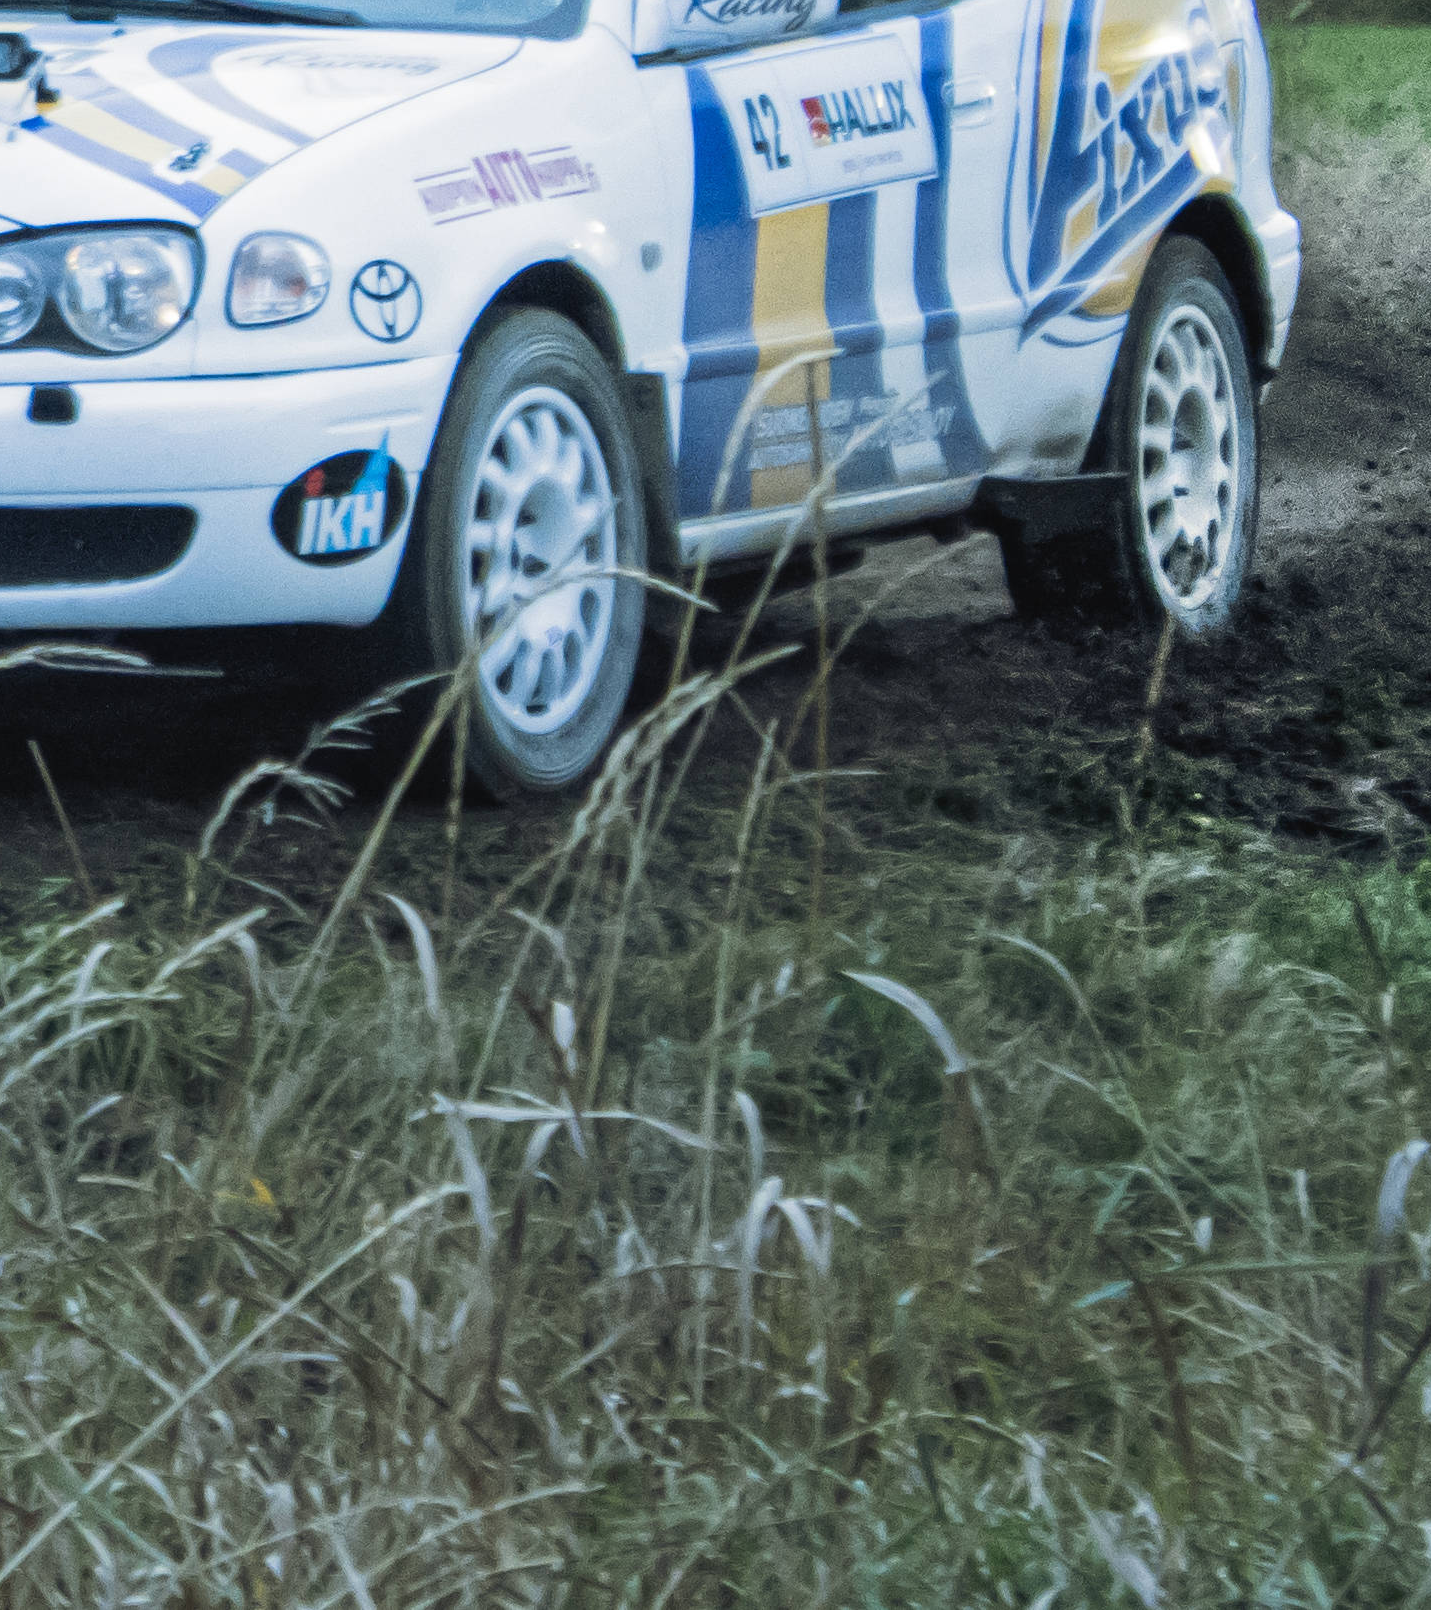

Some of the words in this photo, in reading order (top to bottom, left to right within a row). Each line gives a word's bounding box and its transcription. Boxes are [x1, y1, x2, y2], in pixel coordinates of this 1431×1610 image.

[744, 93, 791, 170] 42
[820, 80, 916, 143] HALLIX
[298, 490, 386, 555] IKH
